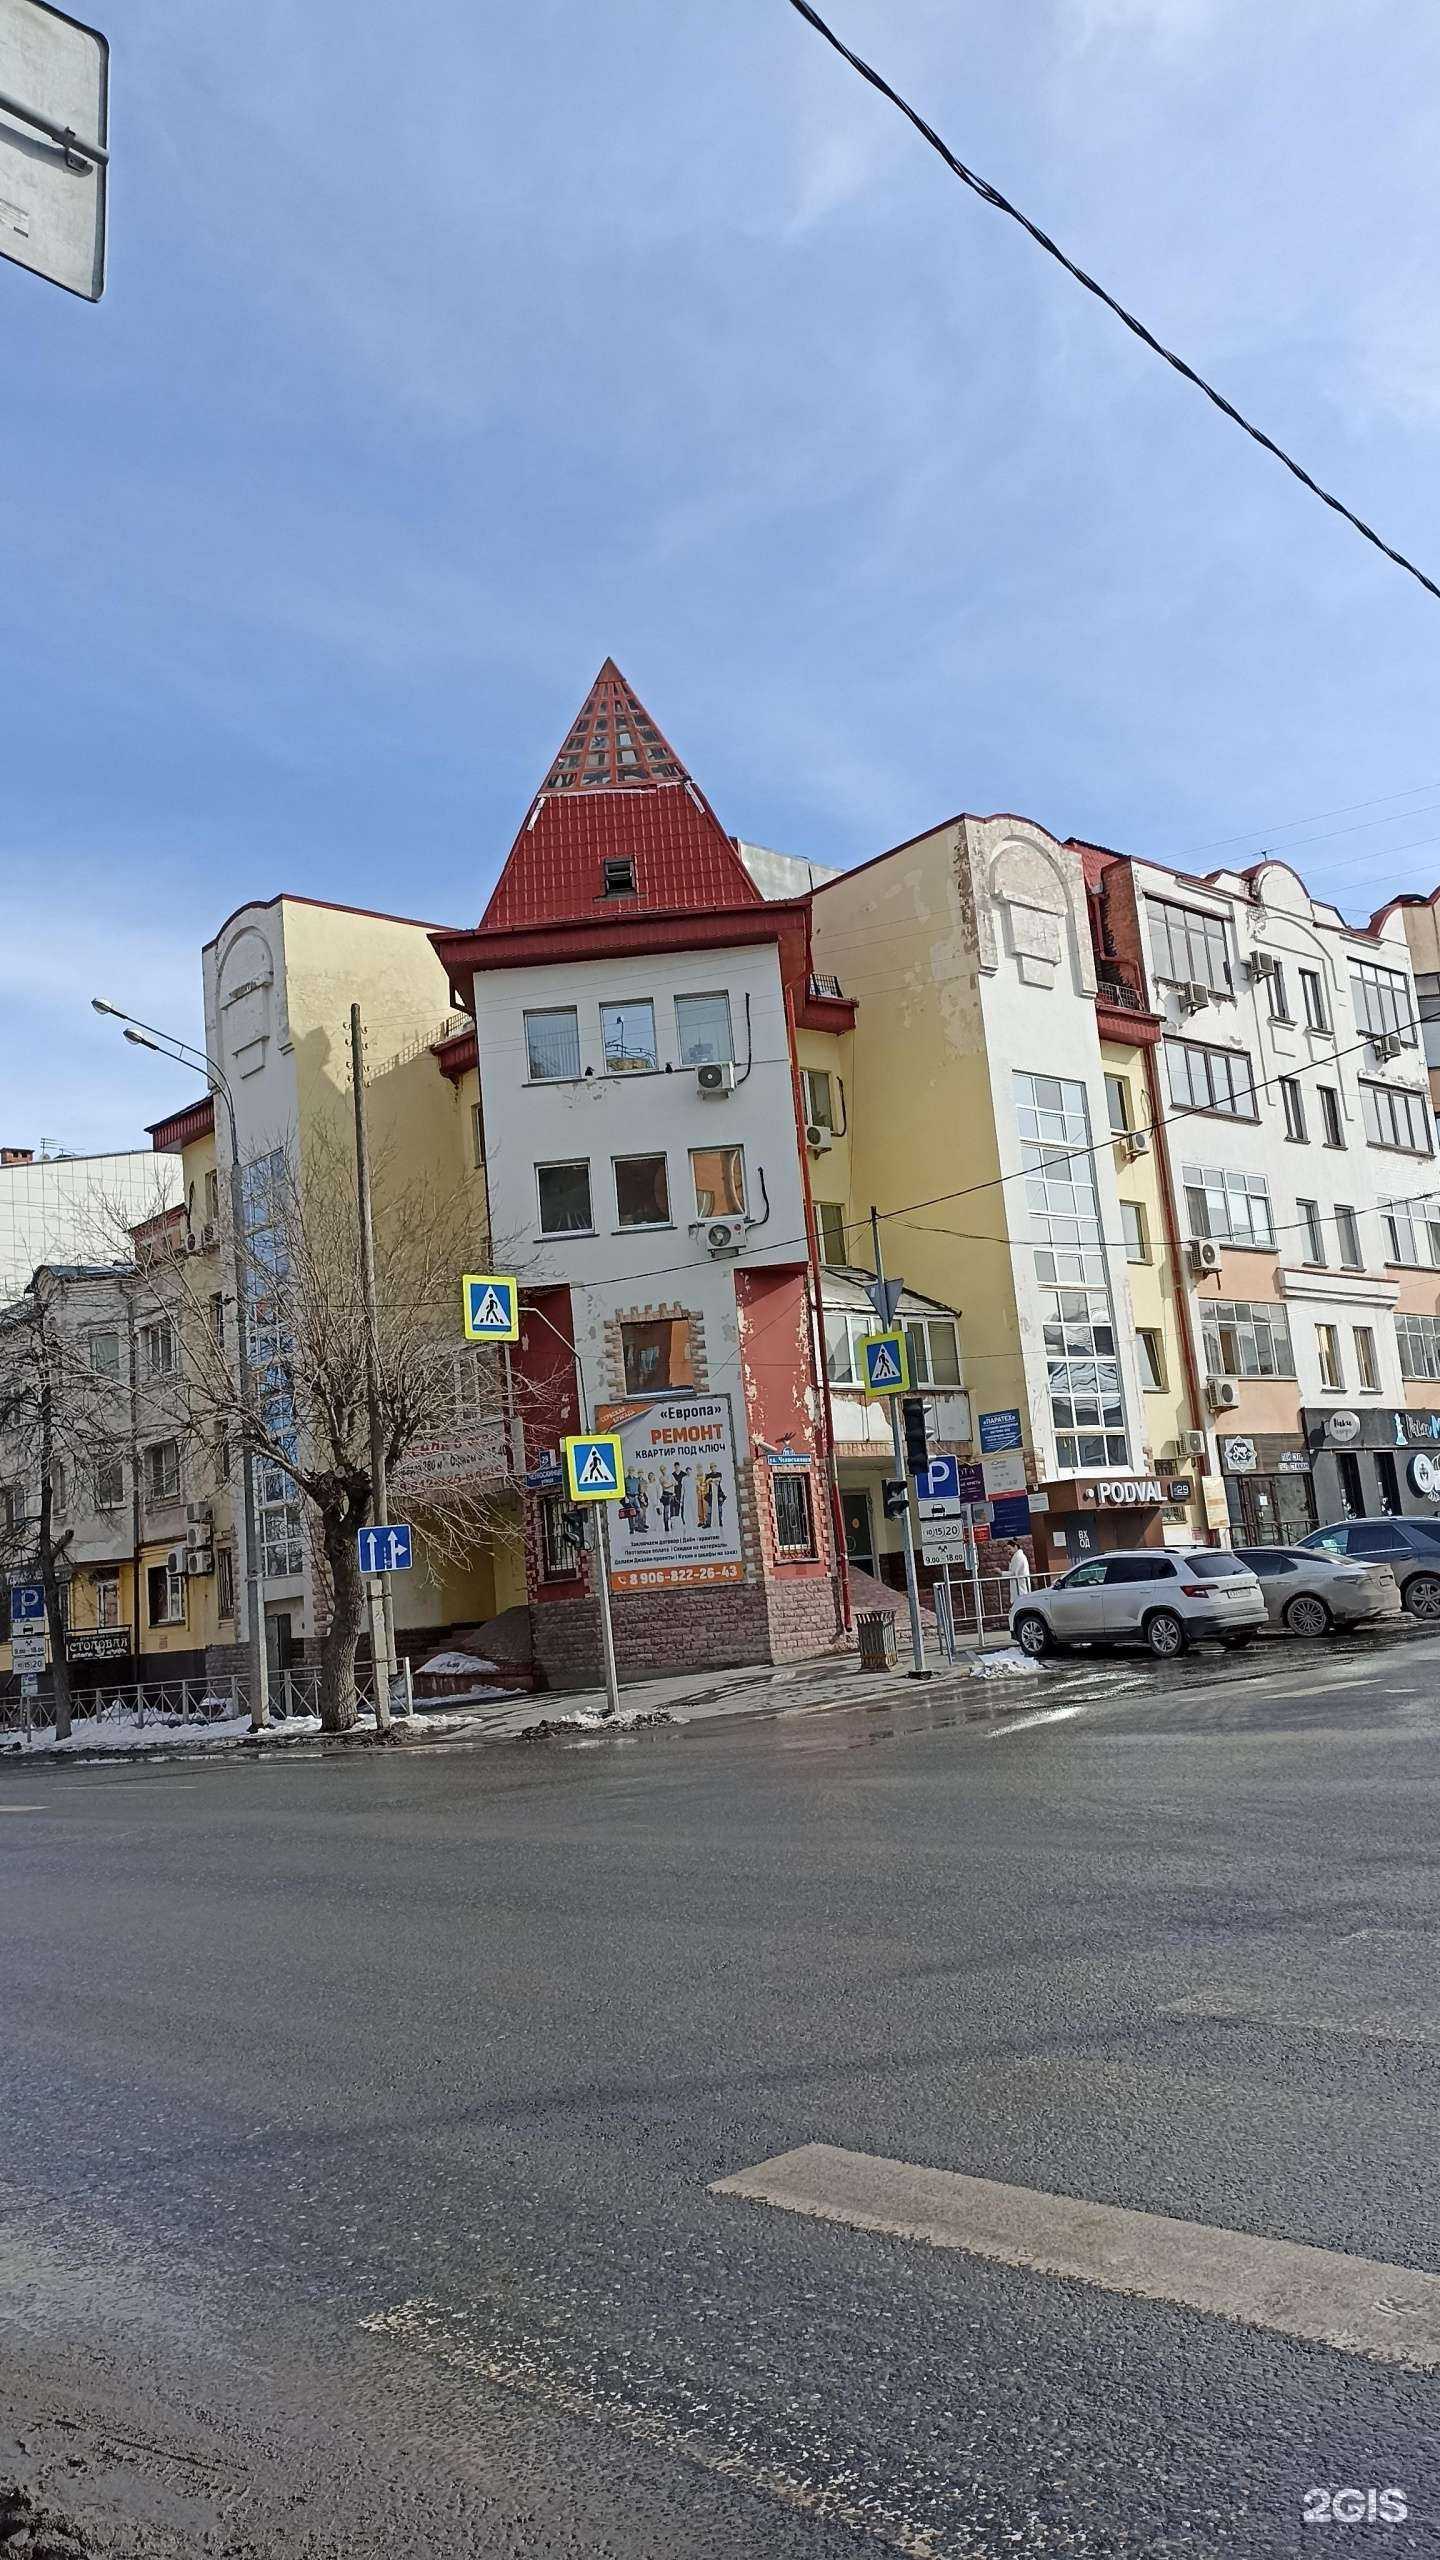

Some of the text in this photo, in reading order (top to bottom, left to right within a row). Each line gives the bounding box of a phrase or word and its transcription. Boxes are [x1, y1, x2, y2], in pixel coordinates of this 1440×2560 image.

[660, 1405, 721, 1421] «Европа»
[650, 1424, 723, 1445] РЕМОНТ
[635, 1443, 726, 1459] КВАРТИР ПОД КЛЮЧ
[928, 1461, 950, 1494] P
[1100, 1481, 1168, 1503] PODVAL
[934, 1528, 942, 1536] 15
[945, 1525, 958, 1536] 20
[629, 1564, 738, 1585] 8 906-822-26-43
